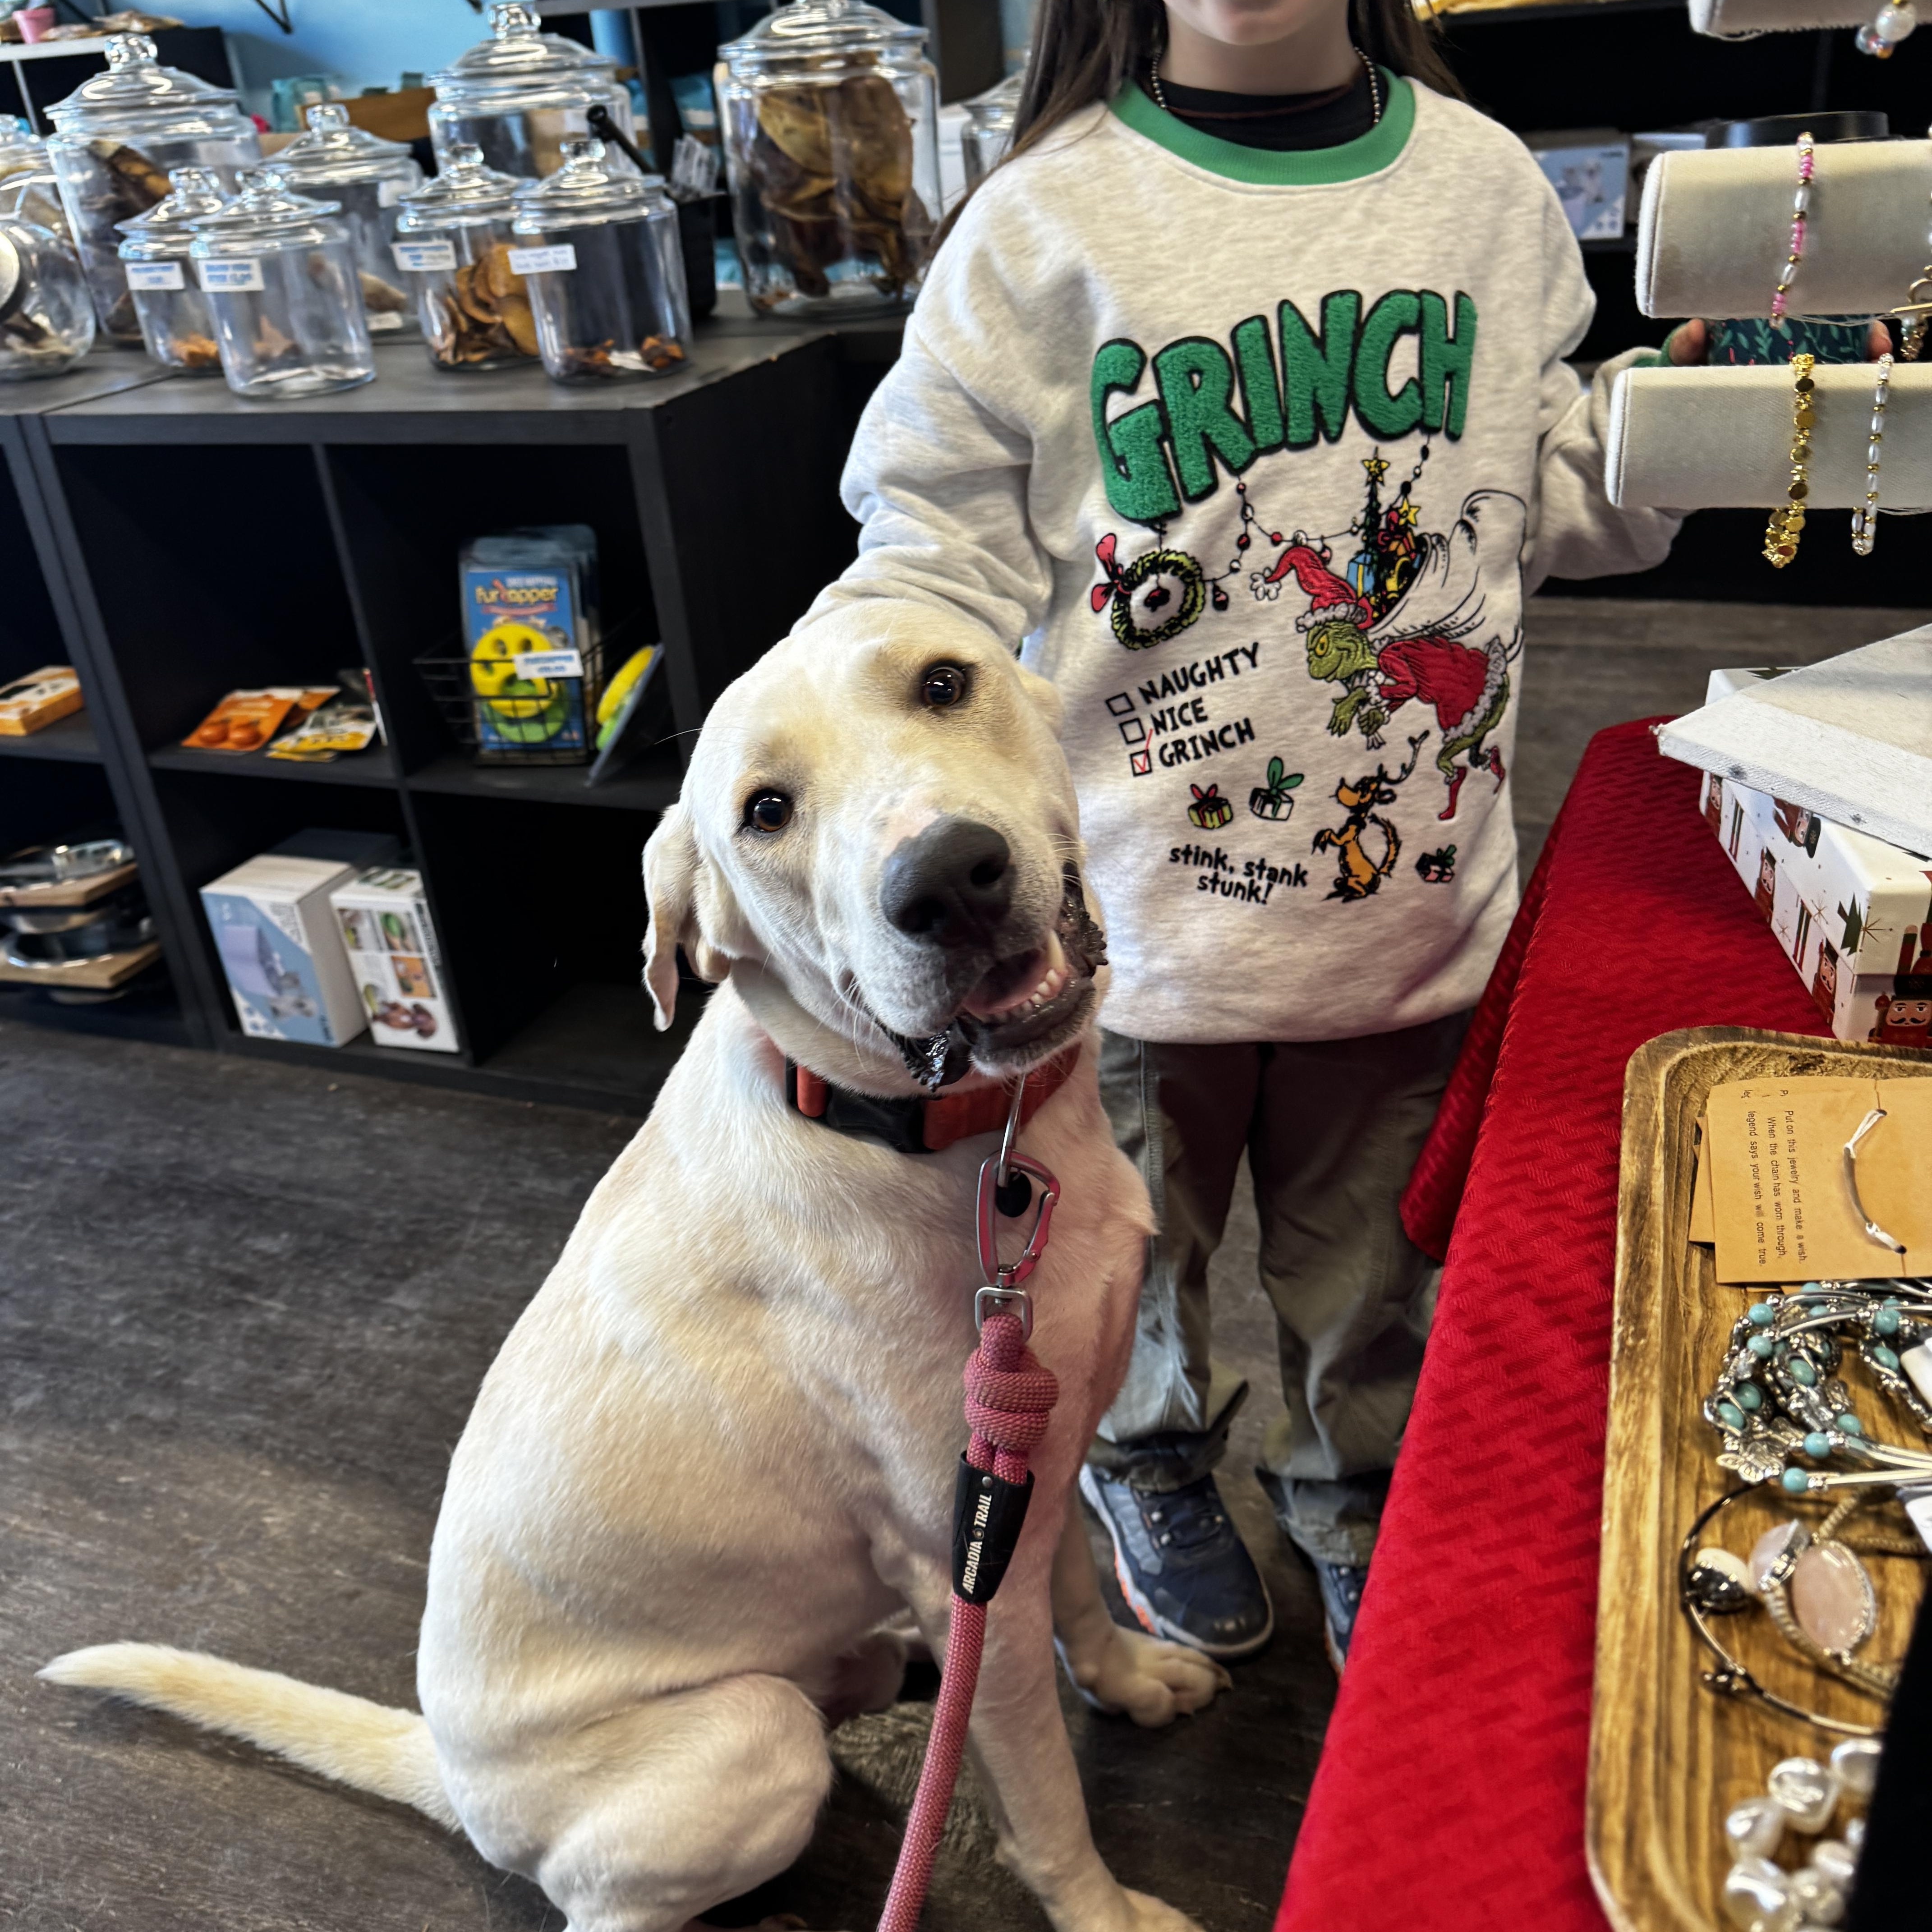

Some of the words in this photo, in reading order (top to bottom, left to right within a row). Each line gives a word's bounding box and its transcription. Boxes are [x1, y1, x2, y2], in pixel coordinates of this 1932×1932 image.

[1090, 289, 1478, 526] GRINCH
[1138, 641, 1259, 704] NAUGHTY
[1150, 697, 1208, 735] NICE
[1158, 718, 1256, 767] GRINCH
[1169, 844, 1234, 874] stink,
[1243, 857, 1307, 888] stank
[1197, 871, 1274, 905] stunk!
[1746, 1111, 1759, 1136] legend
[1785, 1110, 1794, 1123] Put
[1767, 1117, 1776, 1138] When
[1786, 1125, 1794, 1134] on
[1748, 1141, 1758, 1159] says
[1769, 1143, 1778, 1155] the
[1787, 1139, 1796, 1153] this
[1750, 1164, 1760, 1181] your
[1771, 1160, 1780, 1180] chain
[1787, 1157, 1800, 1183] jewelry
[1753, 1182, 1763, 1199] wish
[1773, 1182, 1781, 1196] has
[1792, 1189, 1802, 1203] and
[1775, 1201, 1783, 1220] worn
[1794, 1208, 1804, 1230] make
[1756, 1222, 1765, 1243] come
[961, 1541, 982, 1595] ARCADIA
[974, 1494, 992, 1528] TRAIL
